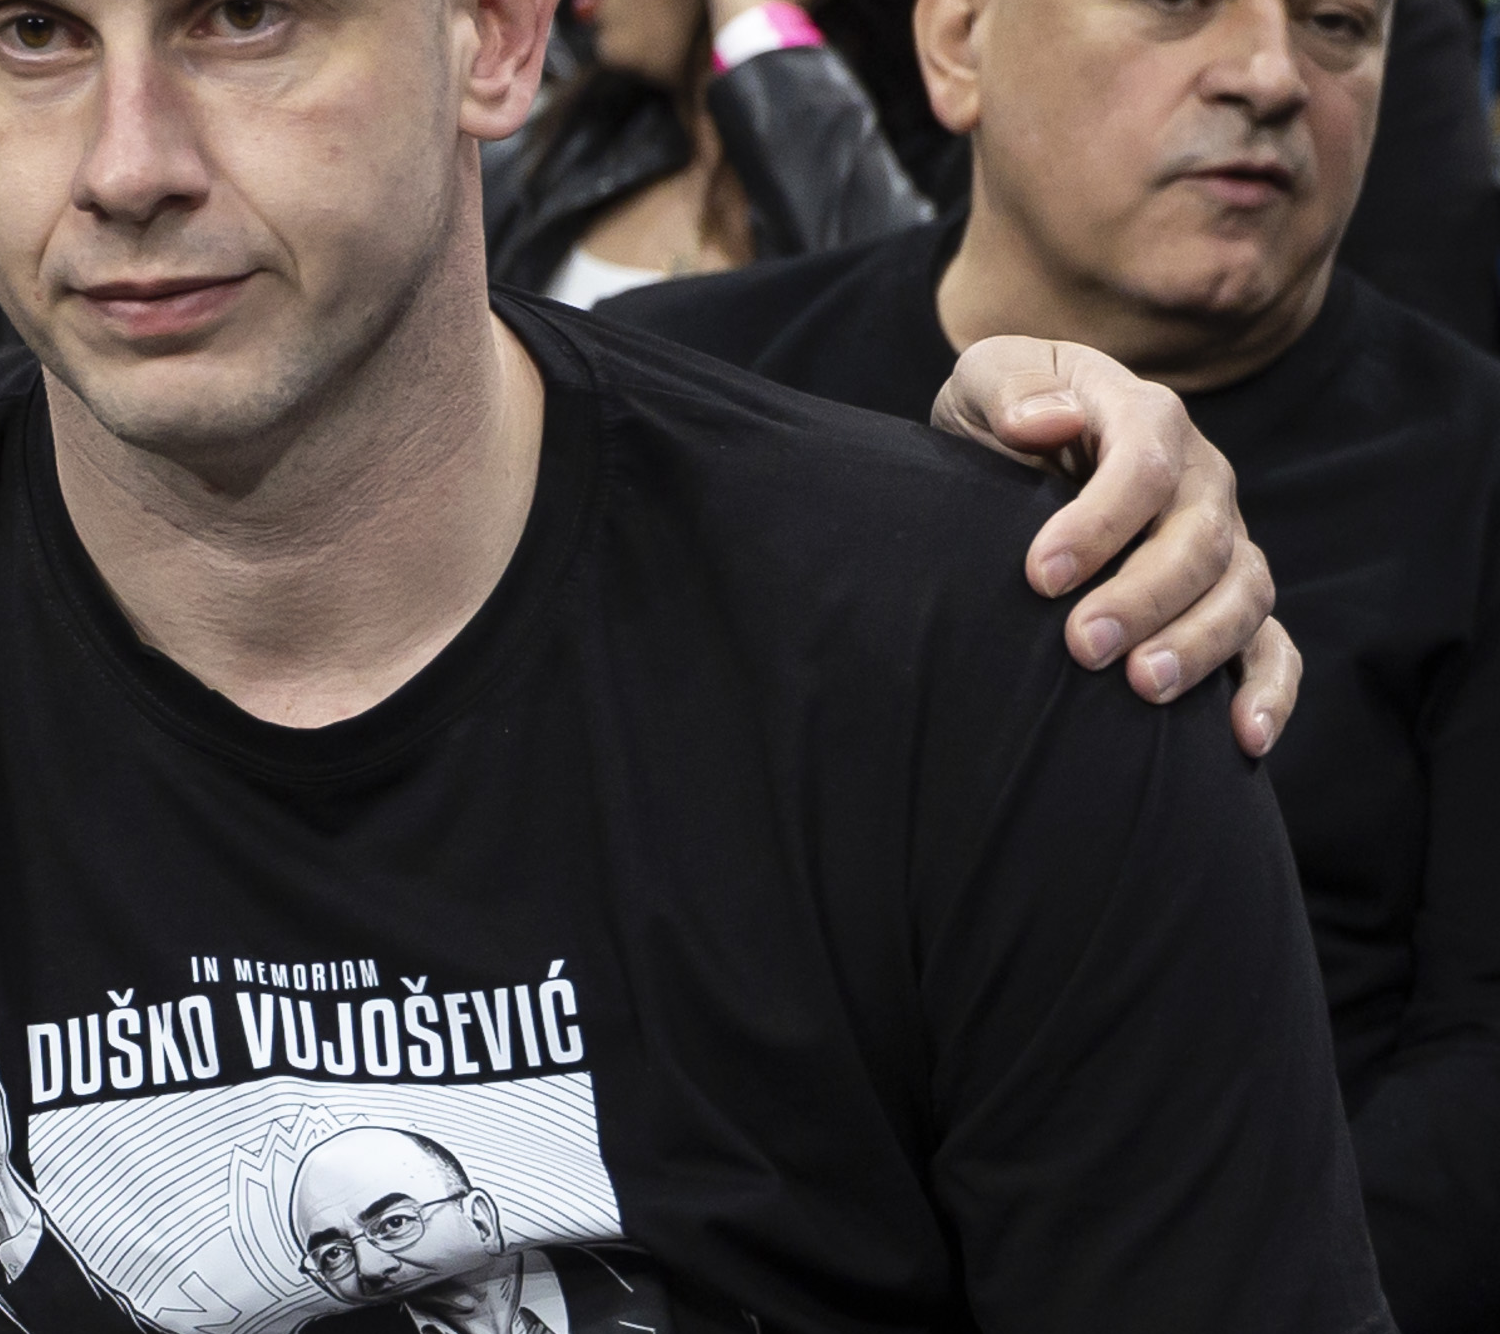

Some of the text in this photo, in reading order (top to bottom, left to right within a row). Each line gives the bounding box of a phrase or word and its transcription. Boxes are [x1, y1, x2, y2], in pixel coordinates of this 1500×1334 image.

[191, 956, 380, 991] IN MEMORIAM
[27, 959, 583, 1103] DUŠKO VUJOŠEVIĆ
